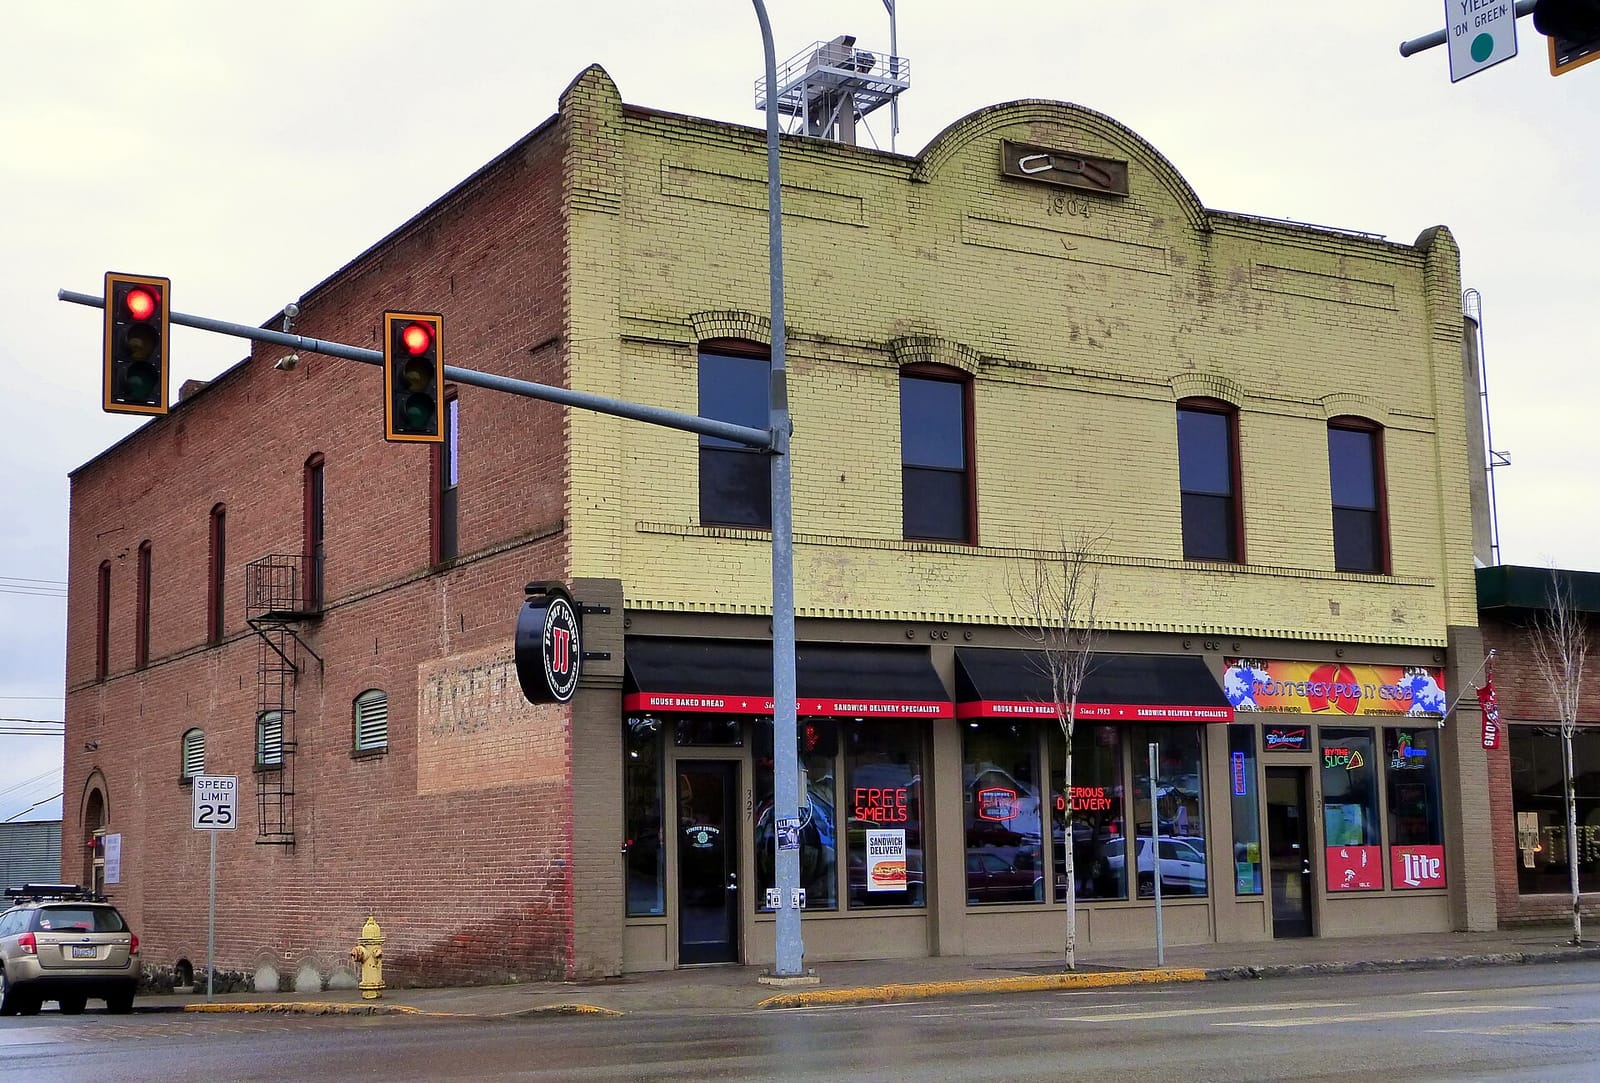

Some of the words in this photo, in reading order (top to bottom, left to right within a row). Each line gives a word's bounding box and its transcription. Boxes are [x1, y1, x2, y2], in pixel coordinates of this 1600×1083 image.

[1460, 0, 1495, 15] YIEL
[1455, 22, 1468, 37] ON
[1474, 4, 1506, 28] GREEN
[1047, 196, 1090, 218] 1904
[1252, 680, 1331, 698] MONTEREY
[1335, 683, 1362, 699] PUB
[1378, 684, 1414, 701] GRUB
[650, 697, 674, 706] HOUSE
[675, 698, 699, 707] BAKED
[701, 699, 724, 708] BREAD
[833, 703, 867, 712] SANDWICH
[869, 704, 899, 713] DELIVERY
[901, 705, 940, 713] SPECIALISTS
[993, 704, 1013, 713] HOUSE
[1035, 706, 1055, 714] BREAD
[1324, 755, 1349, 769] SLICE
[198, 780, 234, 790] SPEED
[201, 792, 230, 801] LIMIT
[855, 787, 908, 808] FREE
[1069, 786, 1105, 799] ERIOUS
[1056, 798, 1112, 811] DLIVERY
[198, 804, 232, 824] 25
[855, 807, 908, 822] SMELLS
[869, 836, 903, 847] SANDWICH
[870, 846, 903, 855] DELIVERY
[1402, 853, 1440, 886] Lite
